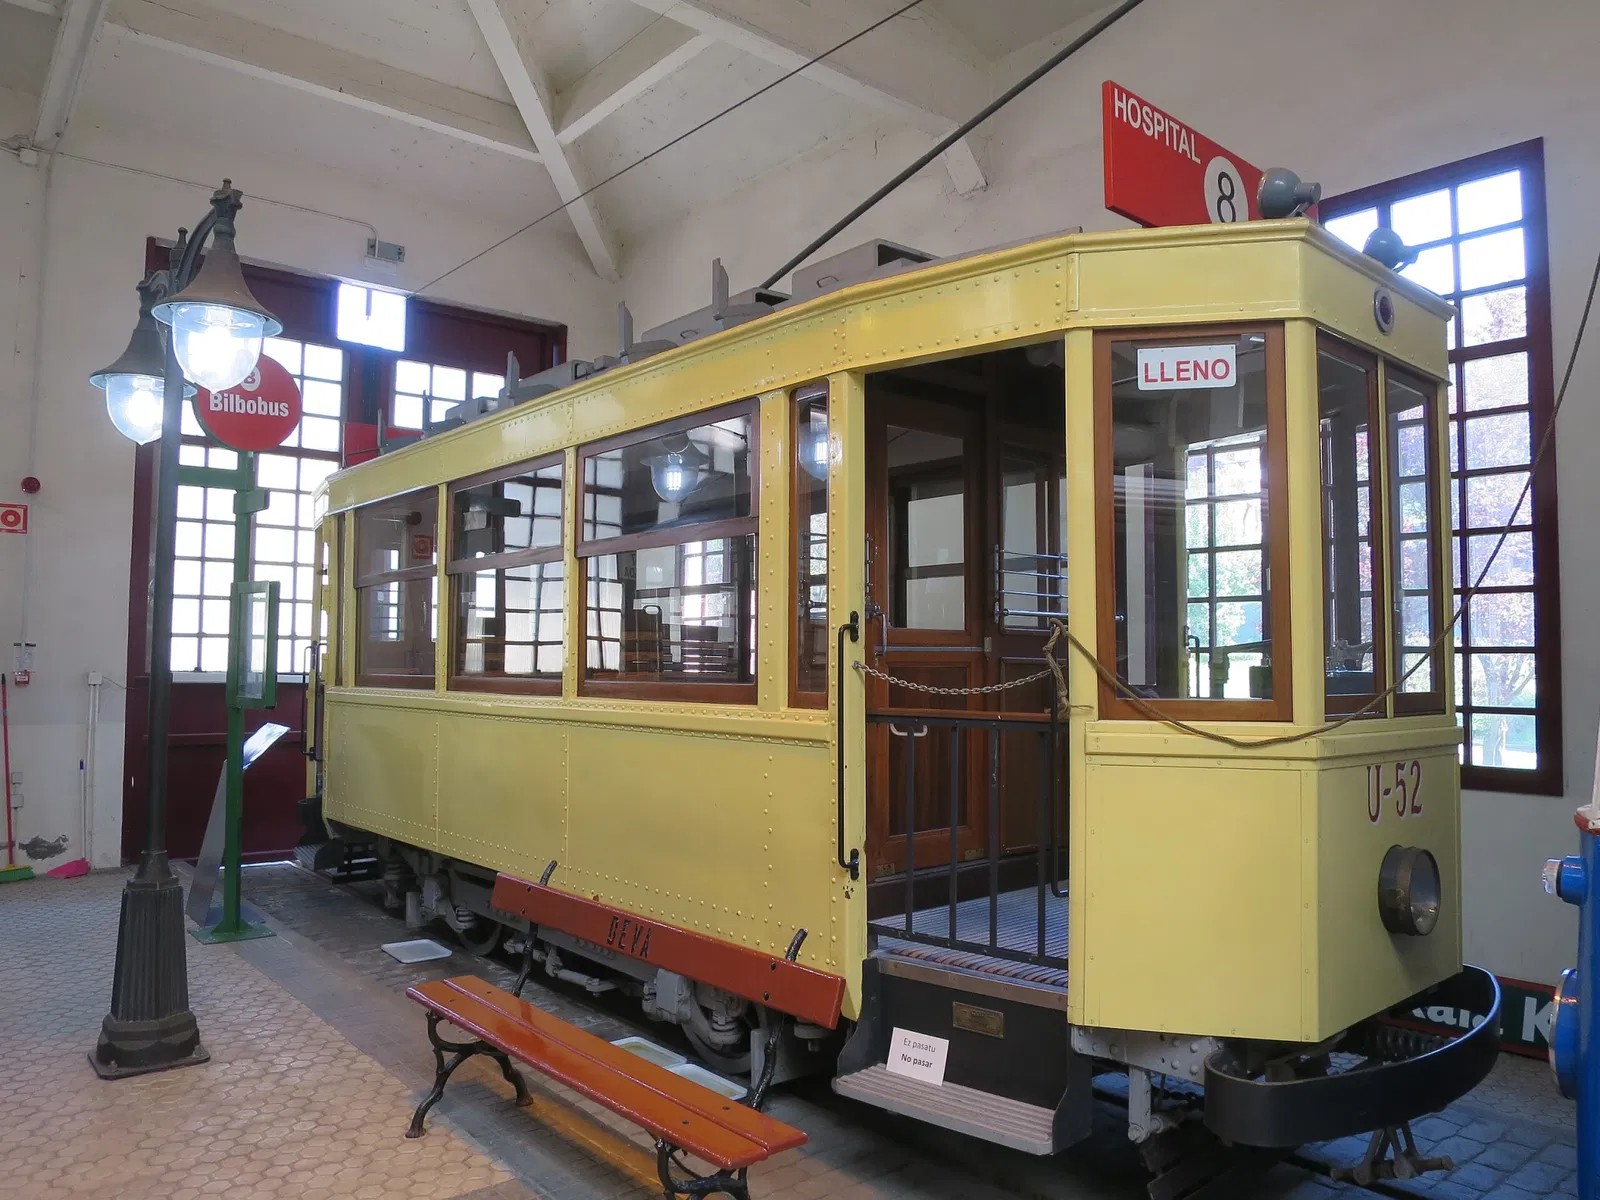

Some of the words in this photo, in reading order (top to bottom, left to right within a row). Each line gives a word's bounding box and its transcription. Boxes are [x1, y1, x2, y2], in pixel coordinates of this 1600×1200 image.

[1113, 87, 1202, 165] HOSPITAL
[1216, 171, 1237, 223] 8
[1143, 358, 1230, 383] LLENO
[209, 392, 290, 417] Bilbobus
[1366, 760, 1424, 824] U-52
[903, 1037, 911, 1047] Ez
[912, 1041, 936, 1053] pasatu
[901, 1053, 912, 1063] No
[912, 1058, 933, 1069] pasar
